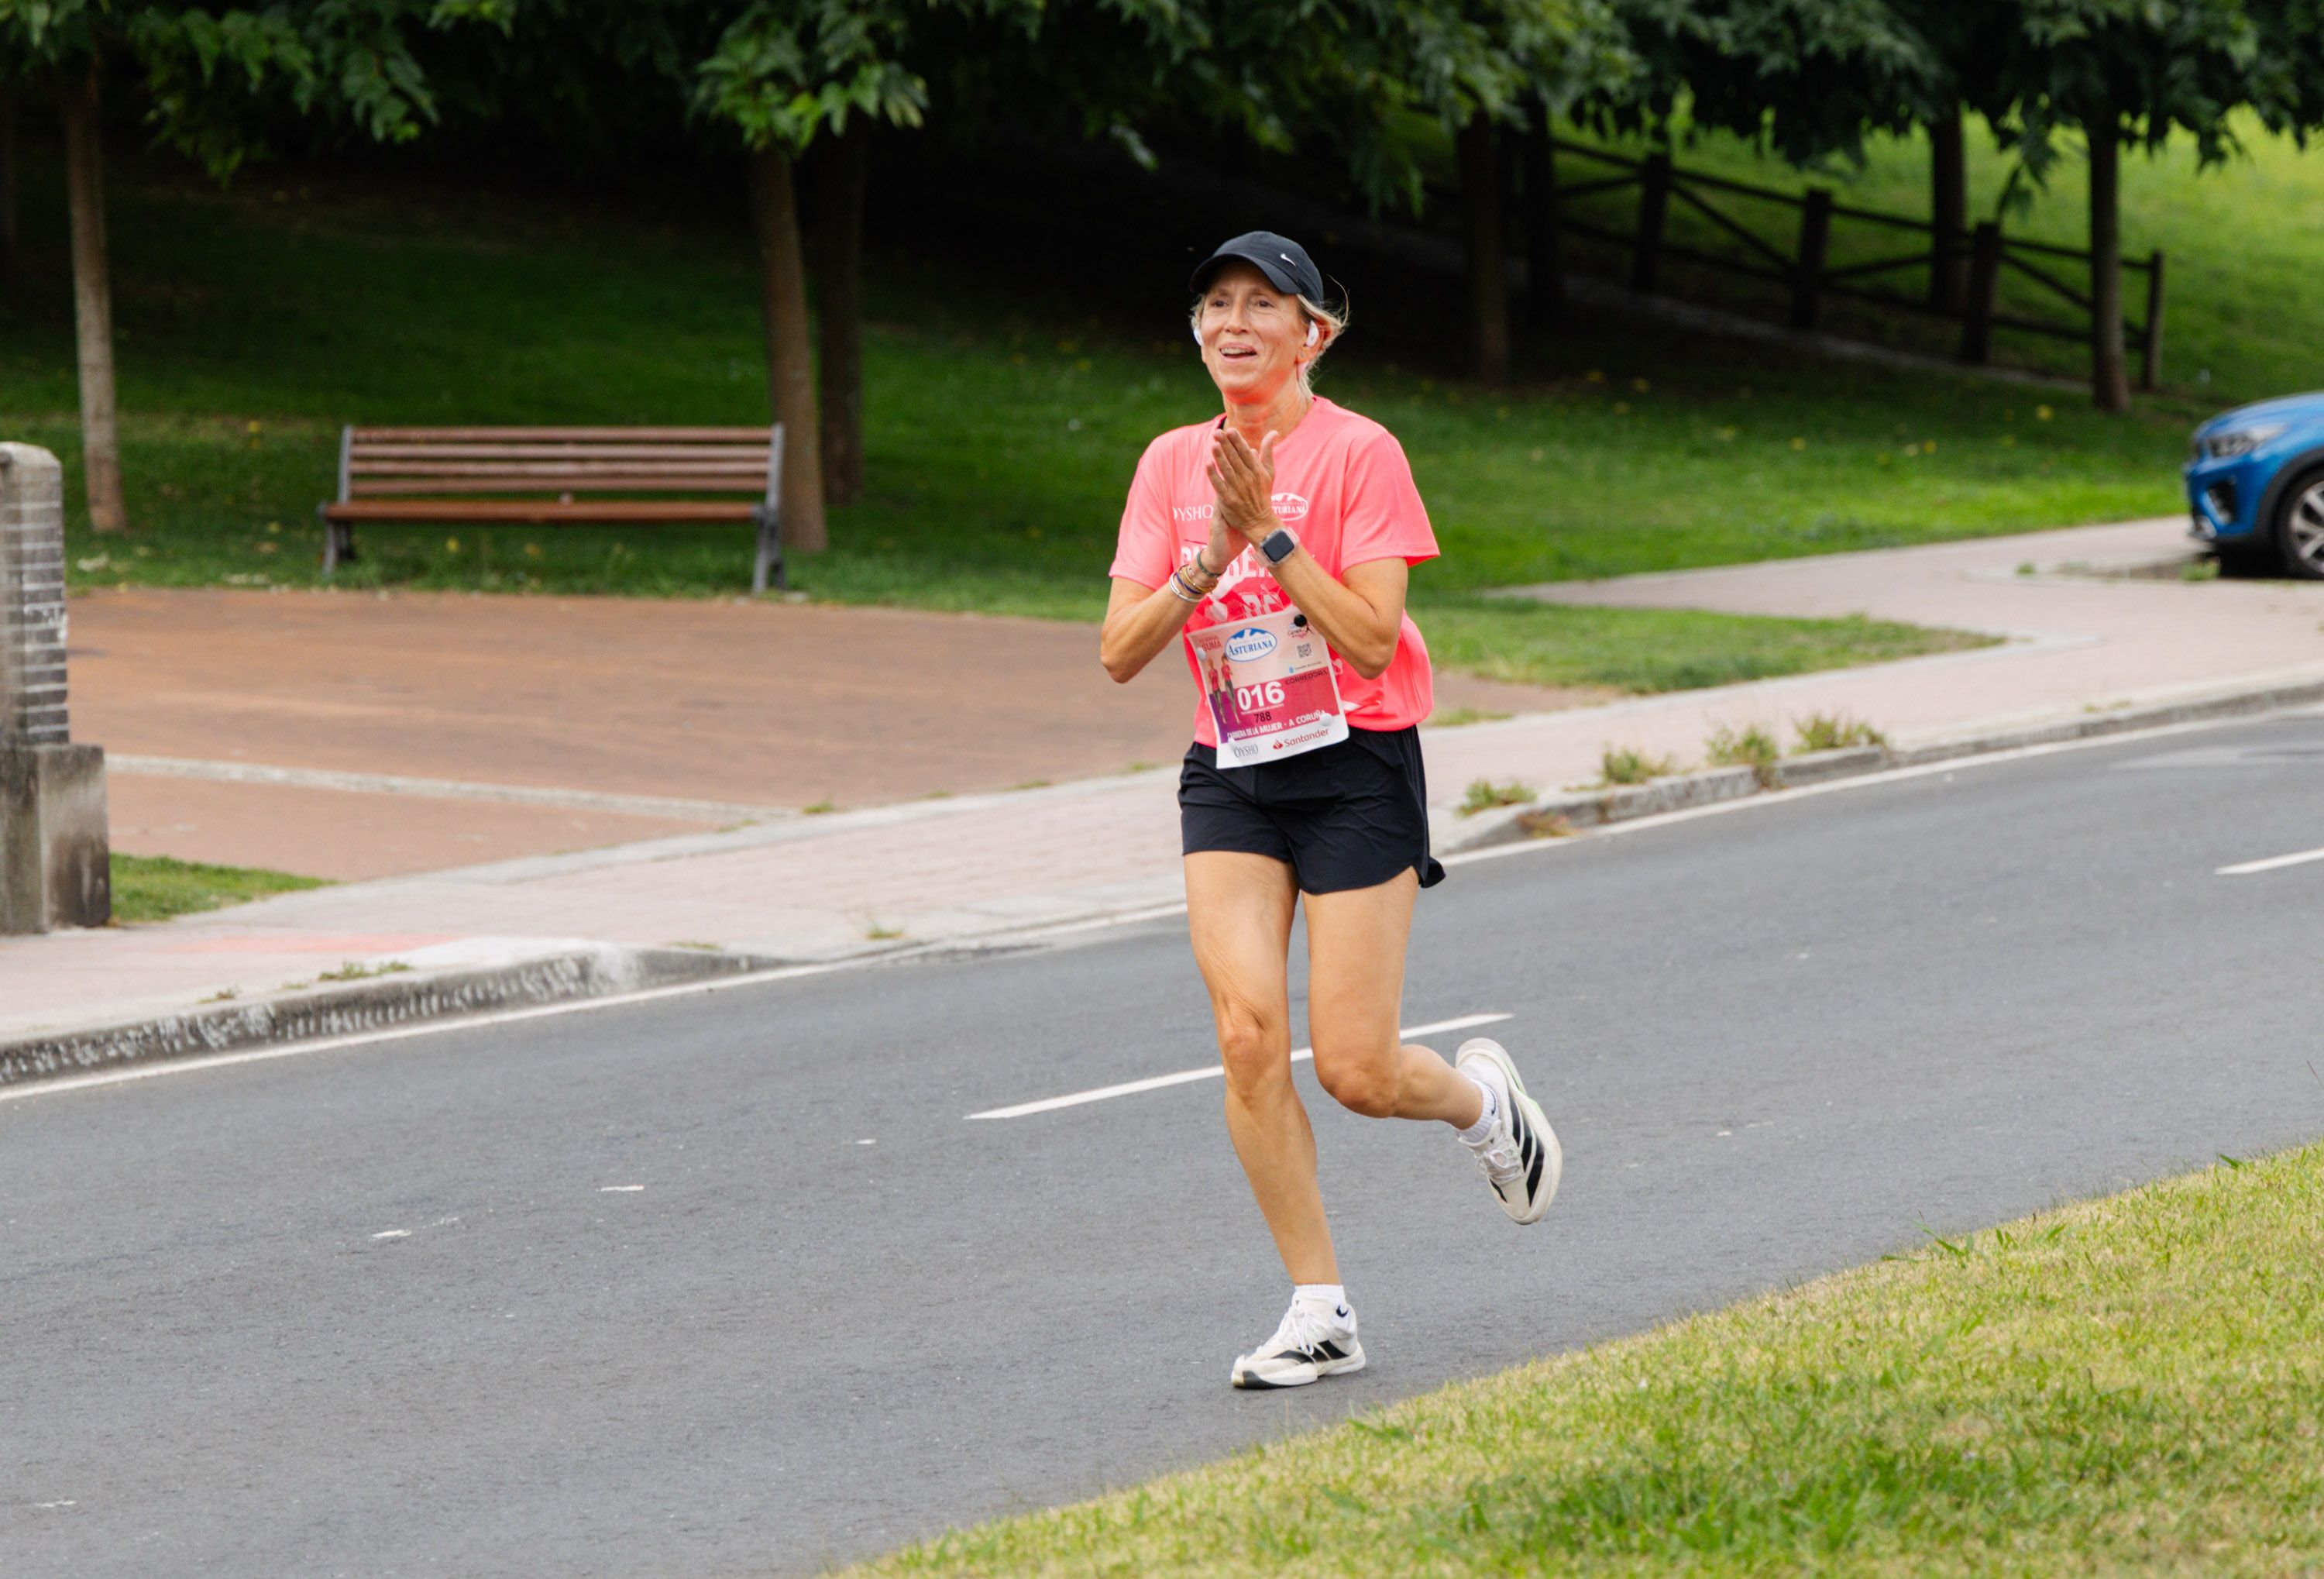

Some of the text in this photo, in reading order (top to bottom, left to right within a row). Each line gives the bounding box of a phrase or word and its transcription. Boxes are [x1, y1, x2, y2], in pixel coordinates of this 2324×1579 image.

[1229, 640, 1274, 655] ASTURIANA
[1285, 669, 1328, 685] CORREDORA
[1237, 681, 1285, 710] 016
[1254, 711, 1271, 723] 788
[1259, 722, 1283, 734] MUJER
[1289, 719, 1295, 728] A
[1284, 728, 1329, 747] Santander
[1233, 744, 1259, 758] OYSHO
